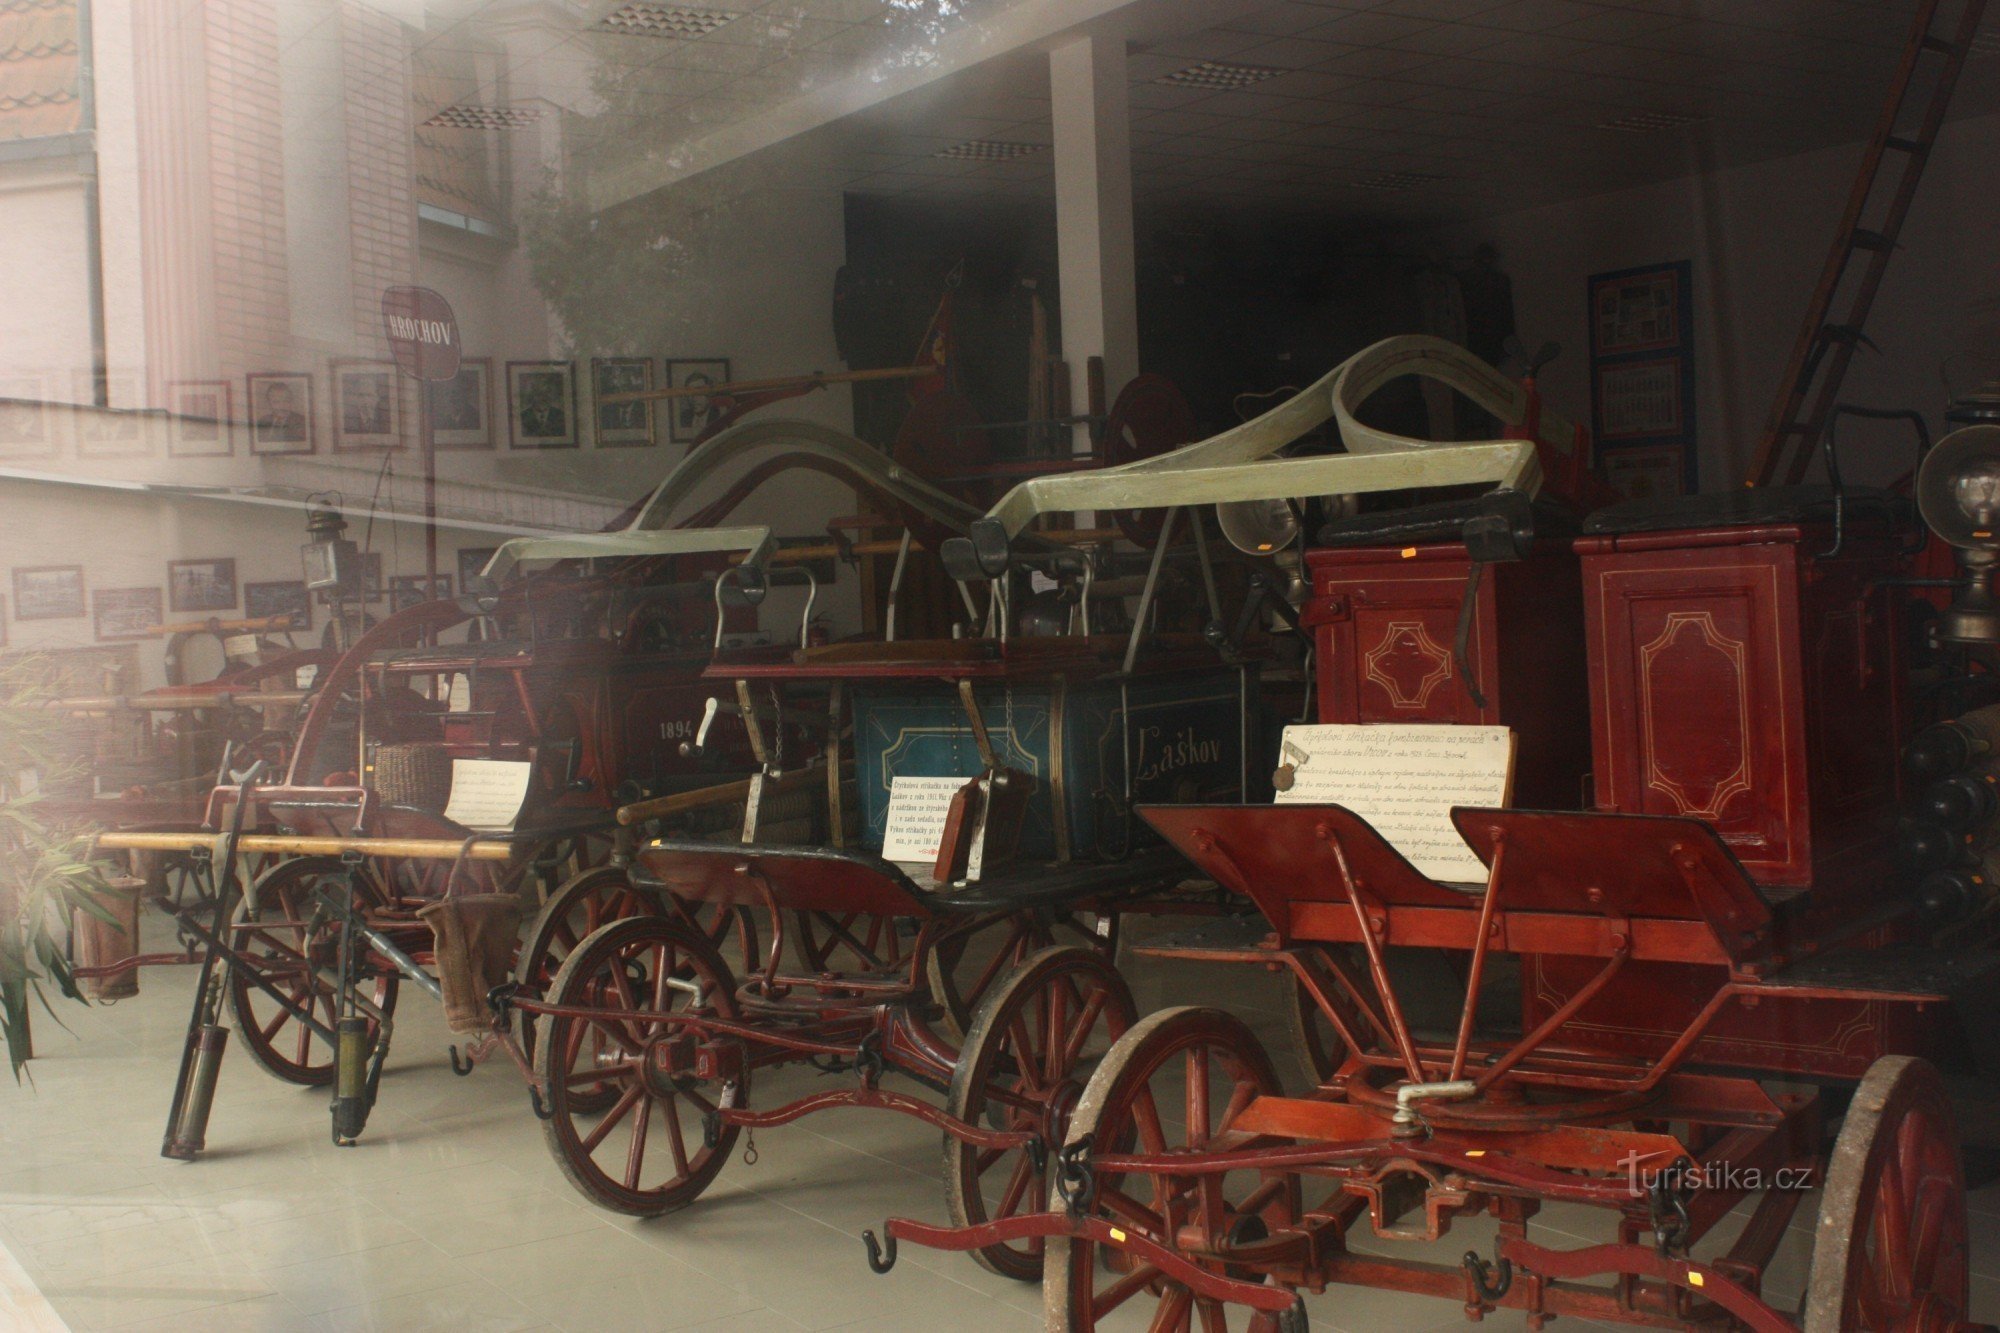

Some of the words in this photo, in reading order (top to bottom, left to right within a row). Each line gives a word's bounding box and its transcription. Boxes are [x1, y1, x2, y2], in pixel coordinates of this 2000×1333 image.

[389, 314, 450, 345] HROCHOV
[660, 720, 692, 740] 1894
[1135, 725, 1220, 781] Laškov
